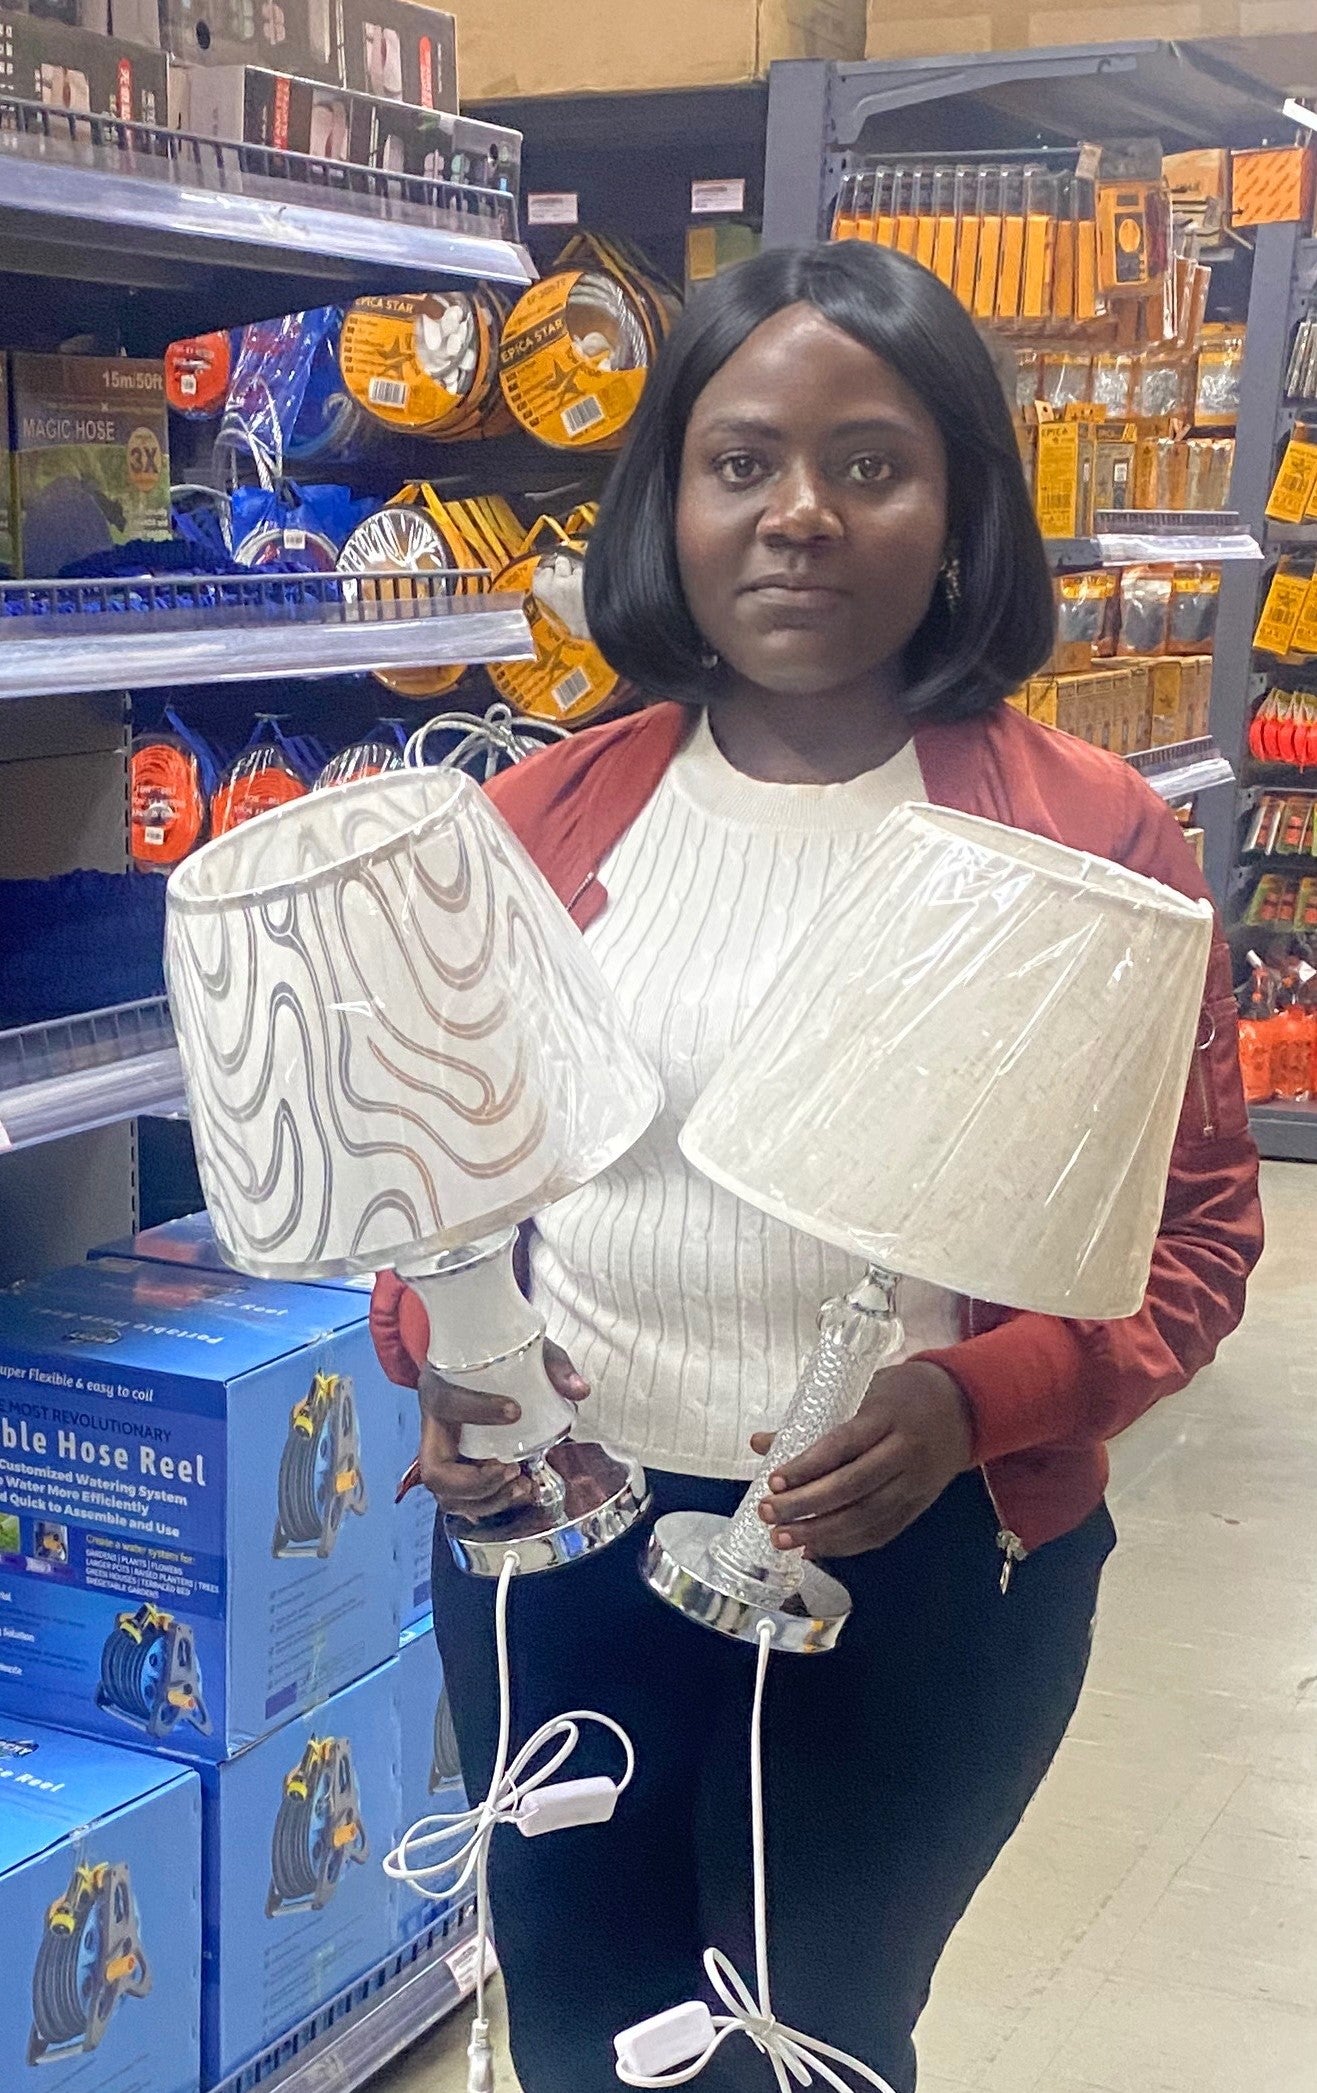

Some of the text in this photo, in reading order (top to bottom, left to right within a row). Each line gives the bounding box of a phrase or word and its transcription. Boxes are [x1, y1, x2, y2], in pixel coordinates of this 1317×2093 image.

[385, 300, 414, 314] STAR
[501, 337, 534, 363] EPICA
[534, 318, 563, 341] STAR
[22, 418, 116, 441] MAGIC HOSE
[130, 446, 158, 474] 3X
[0, 1365, 153, 1402] uper Flexible & easy to coil
[8, 1401, 48, 1420] MOST
[52, 1408, 172, 1442] REVOLUTIONARY
[1, 1417, 206, 1487] ble Hose Reel
[6, 1476, 45, 1494] Water
[48, 1484, 80, 1500] More
[82, 1491, 150, 1517] Efficiently
[76, 1473, 136, 1497] Watering
[138, 1486, 188, 1506] System
[10, 1492, 47, 1511] Quick
[49, 1499, 62, 1513] to
[64, 1504, 127, 1527] Assemble
[129, 1517, 154, 1532] and
[155, 1520, 180, 1538] Use
[121, 1555, 147, 1568] PLANTS
[14, 1773, 65, 1793] Reel
